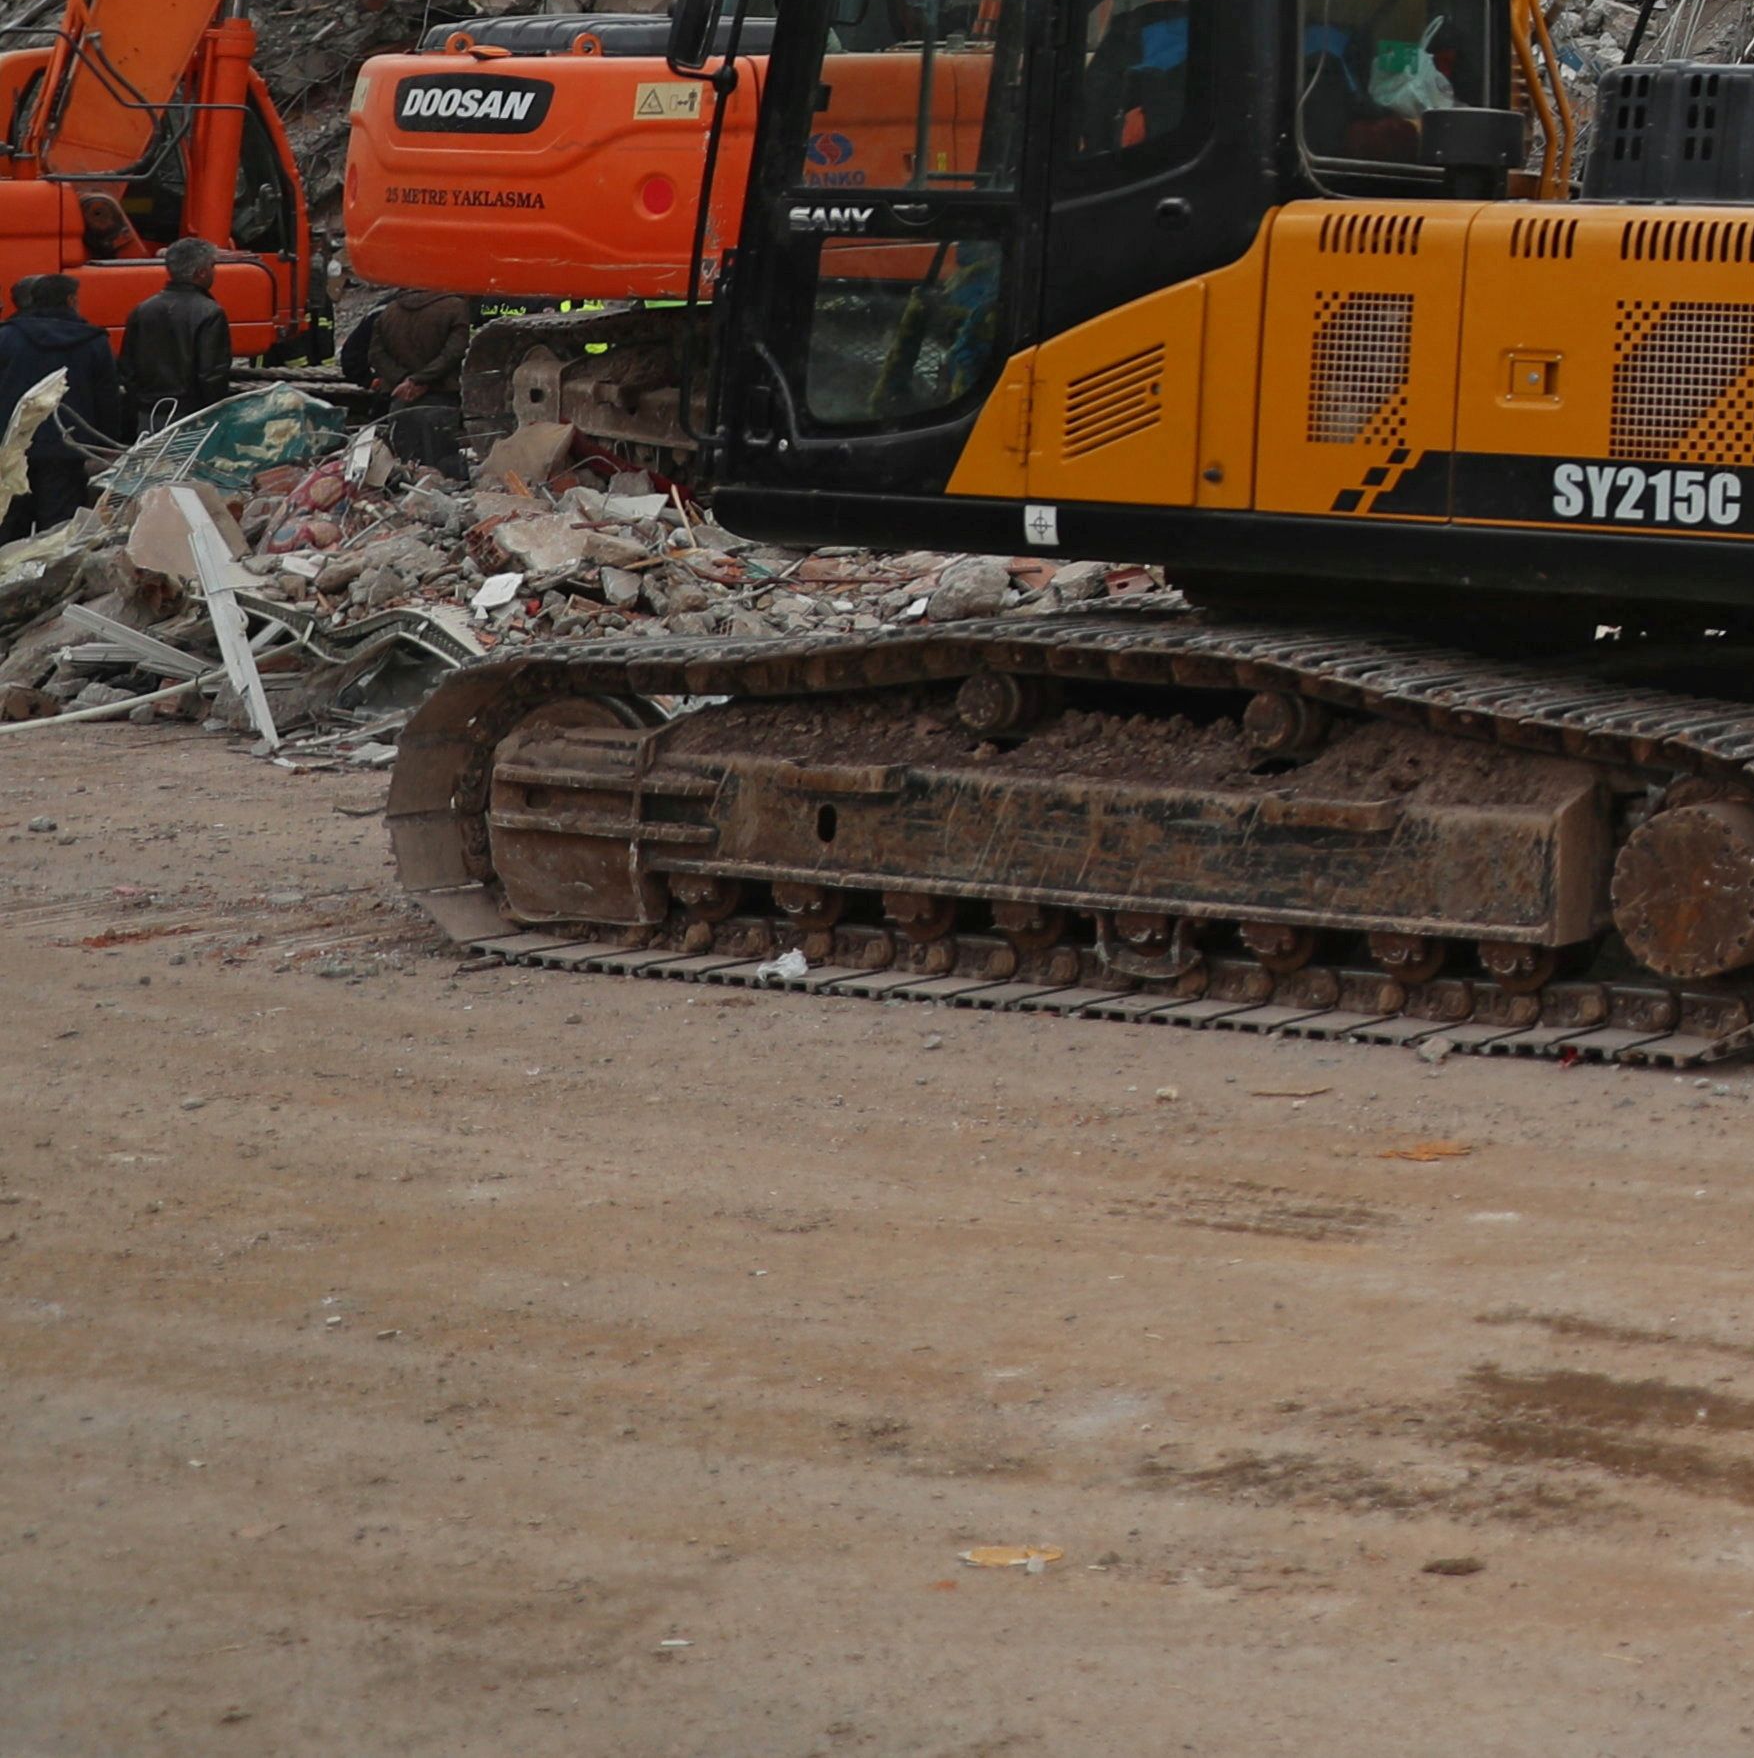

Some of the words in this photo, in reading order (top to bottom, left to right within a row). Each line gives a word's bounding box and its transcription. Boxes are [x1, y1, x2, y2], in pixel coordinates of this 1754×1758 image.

[401, 87, 536, 121] DOOSAN
[806, 170, 865, 187] ANKO
[385, 189, 399, 205] 25
[400, 189, 448, 207] METRE
[452, 190, 545, 210] YAKLASMA
[789, 207, 873, 231] SANY
[1553, 465, 1741, 526] SY215C
